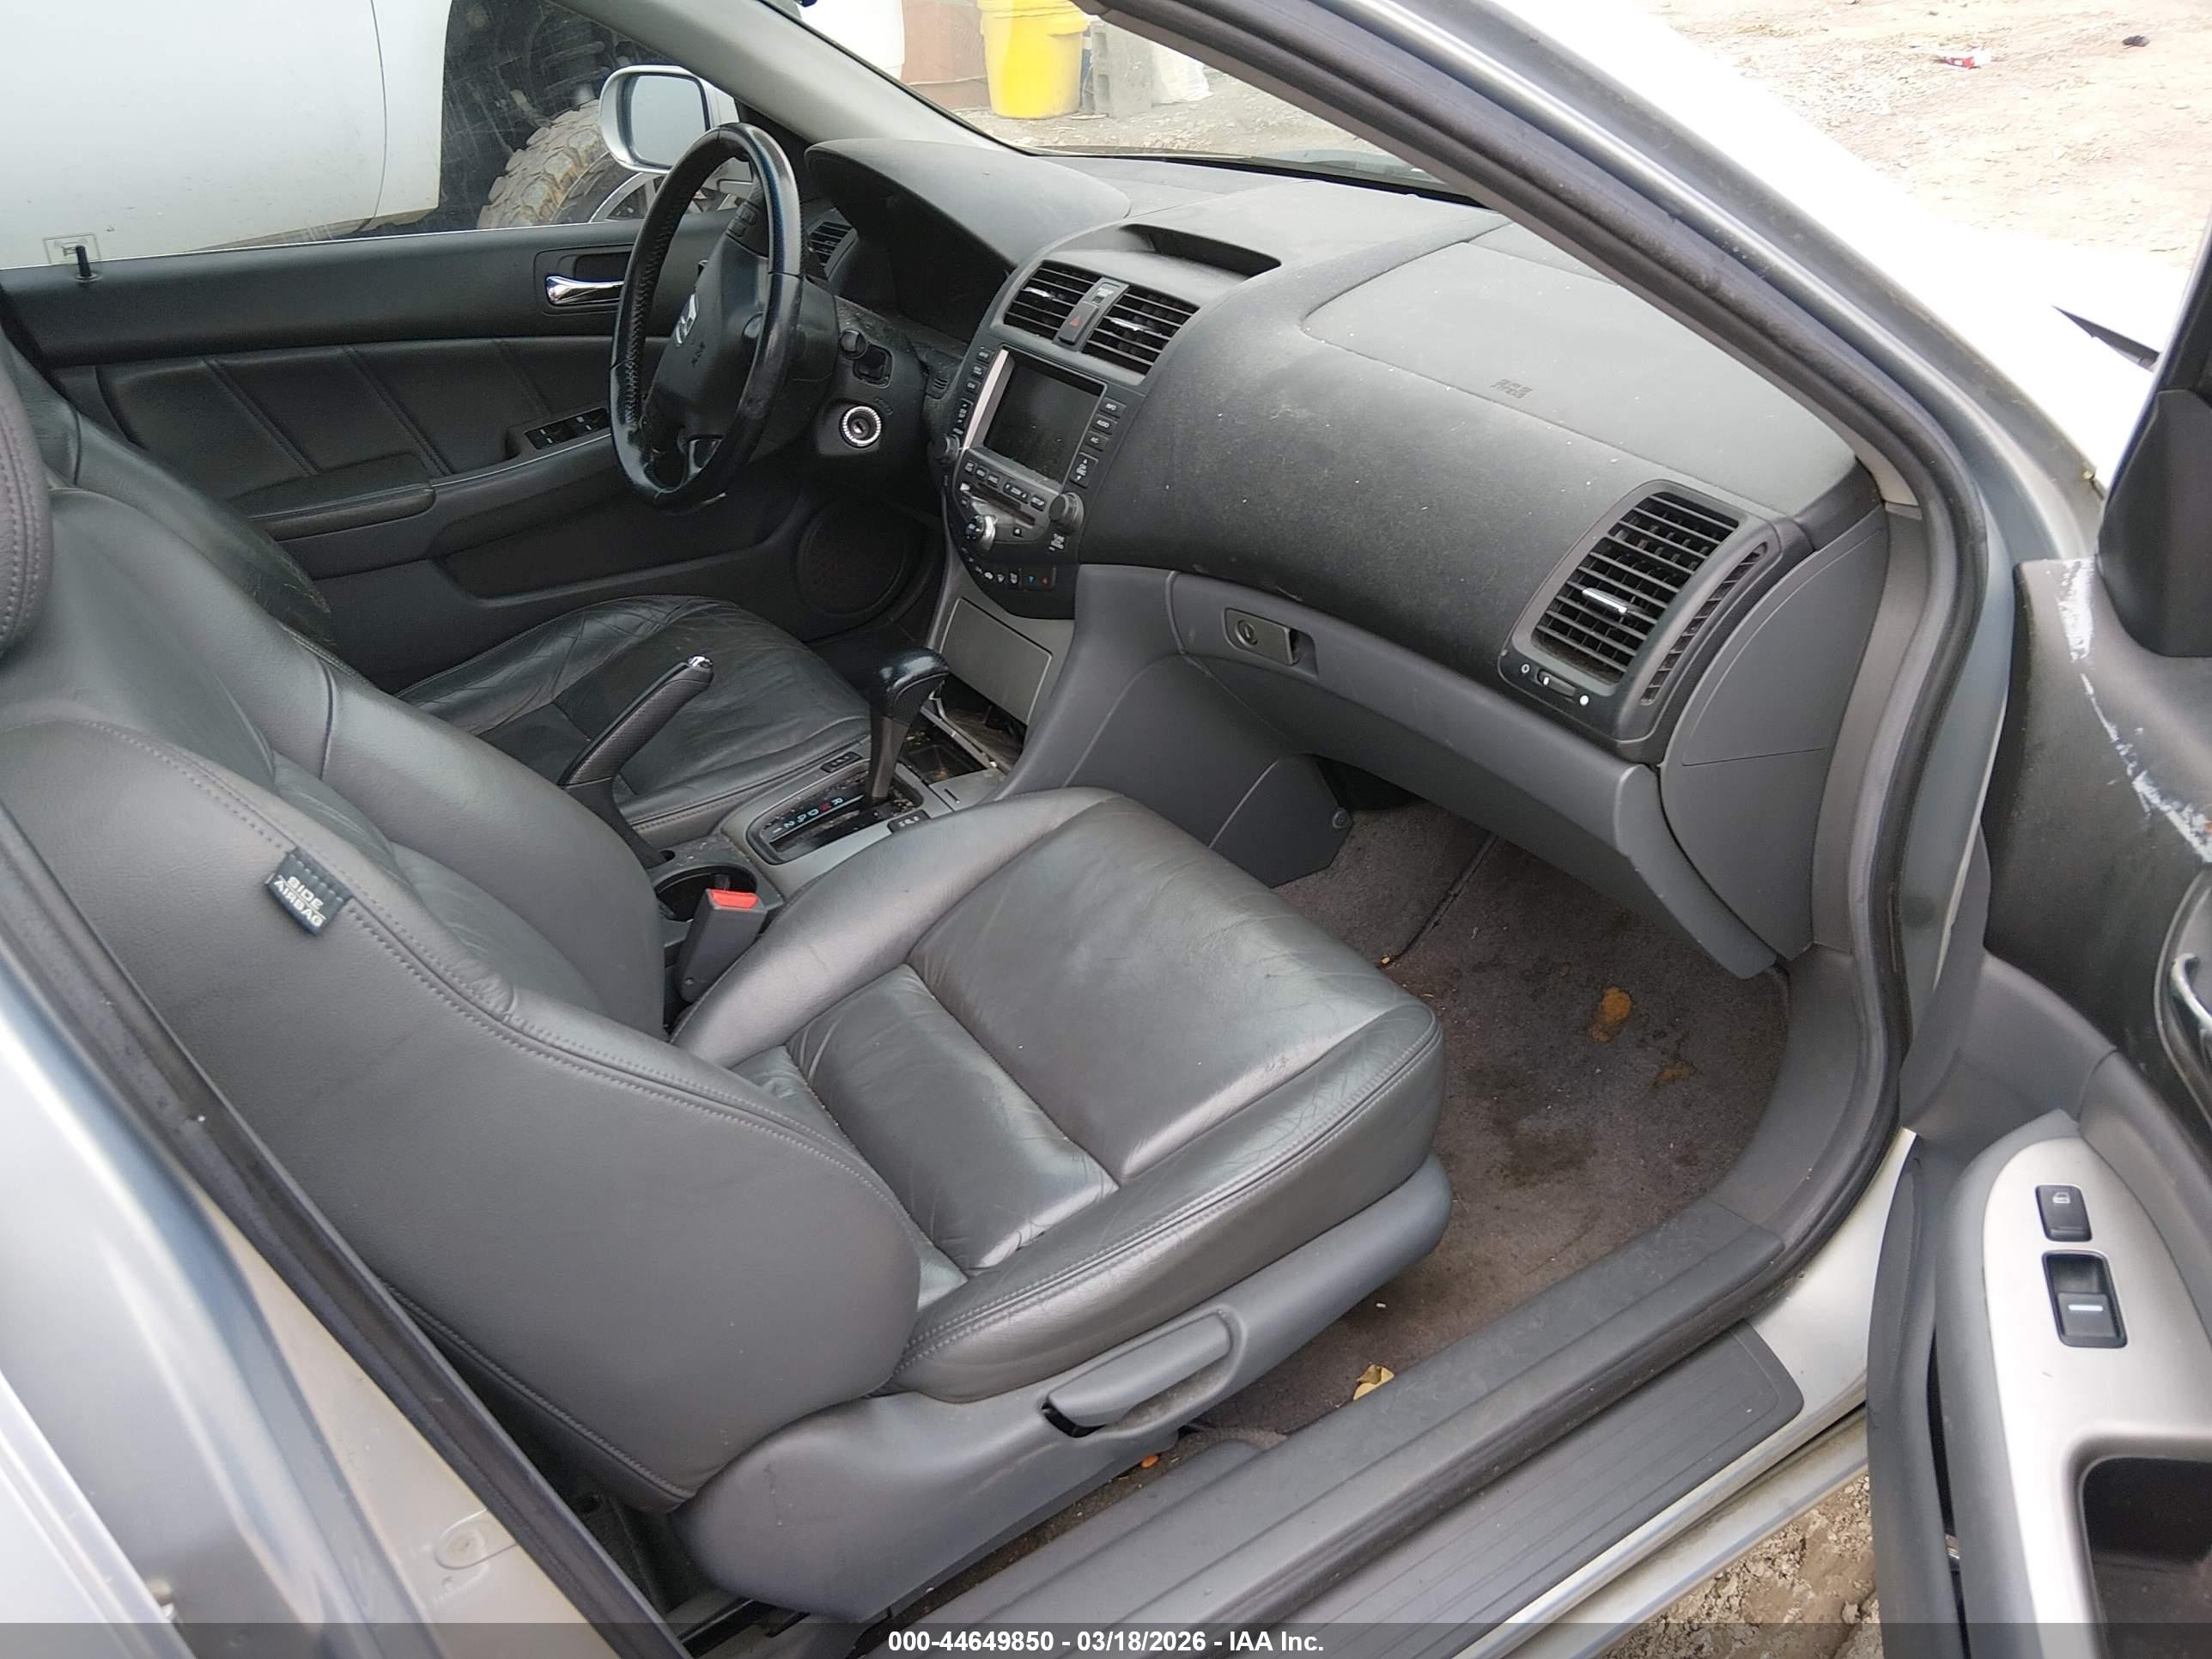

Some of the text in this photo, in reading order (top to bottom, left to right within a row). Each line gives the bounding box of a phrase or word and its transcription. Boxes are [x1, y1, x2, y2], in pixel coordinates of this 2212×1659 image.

[830, 797, 844, 805] R
[806, 808, 820, 817] D
[782, 820, 795, 829] 2
[287, 876, 325, 911] SIDE
[273, 879, 325, 927] AIRBAG
